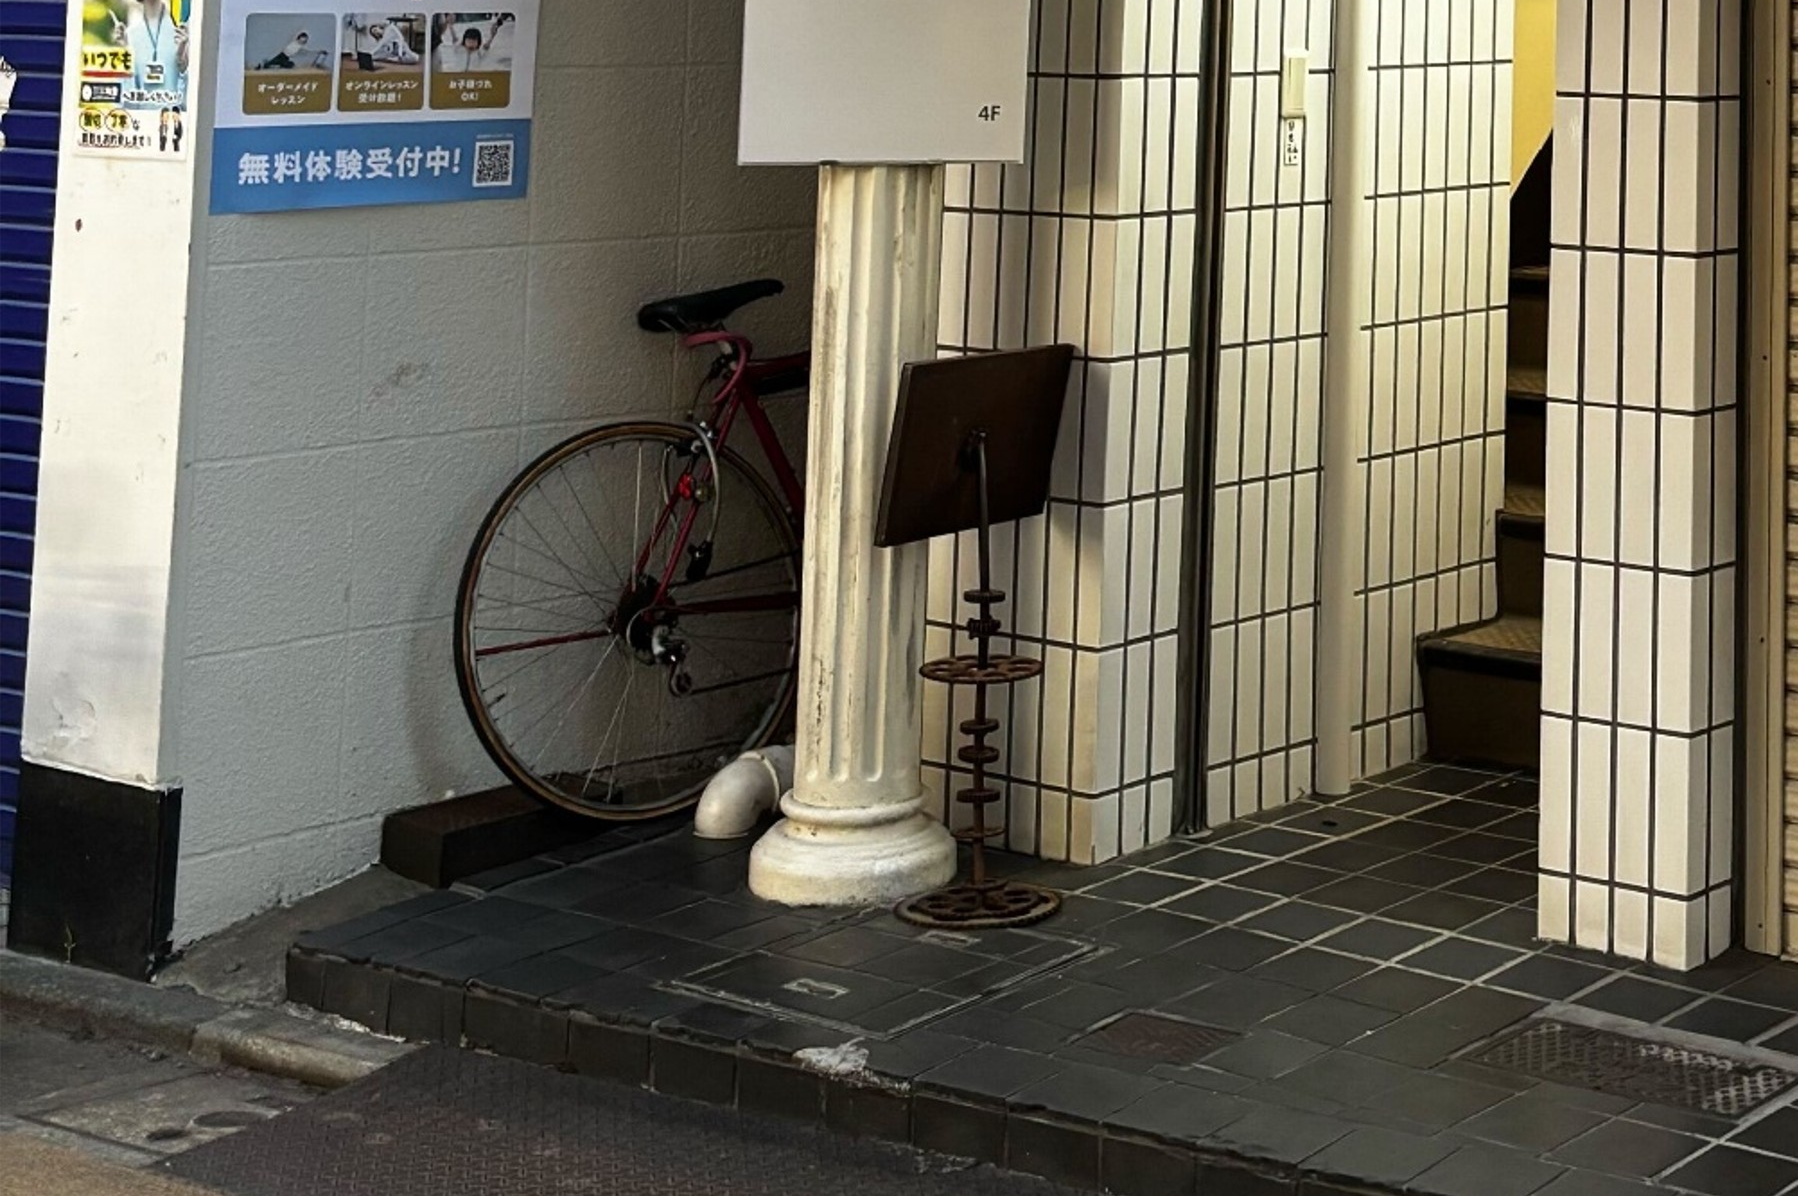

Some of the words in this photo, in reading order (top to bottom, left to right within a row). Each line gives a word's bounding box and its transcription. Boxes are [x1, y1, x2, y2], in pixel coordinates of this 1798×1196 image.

[83, 52, 132, 70] いつでも
[271, 95, 306, 105] レッスン
[978, 105, 1001, 122] 4F
